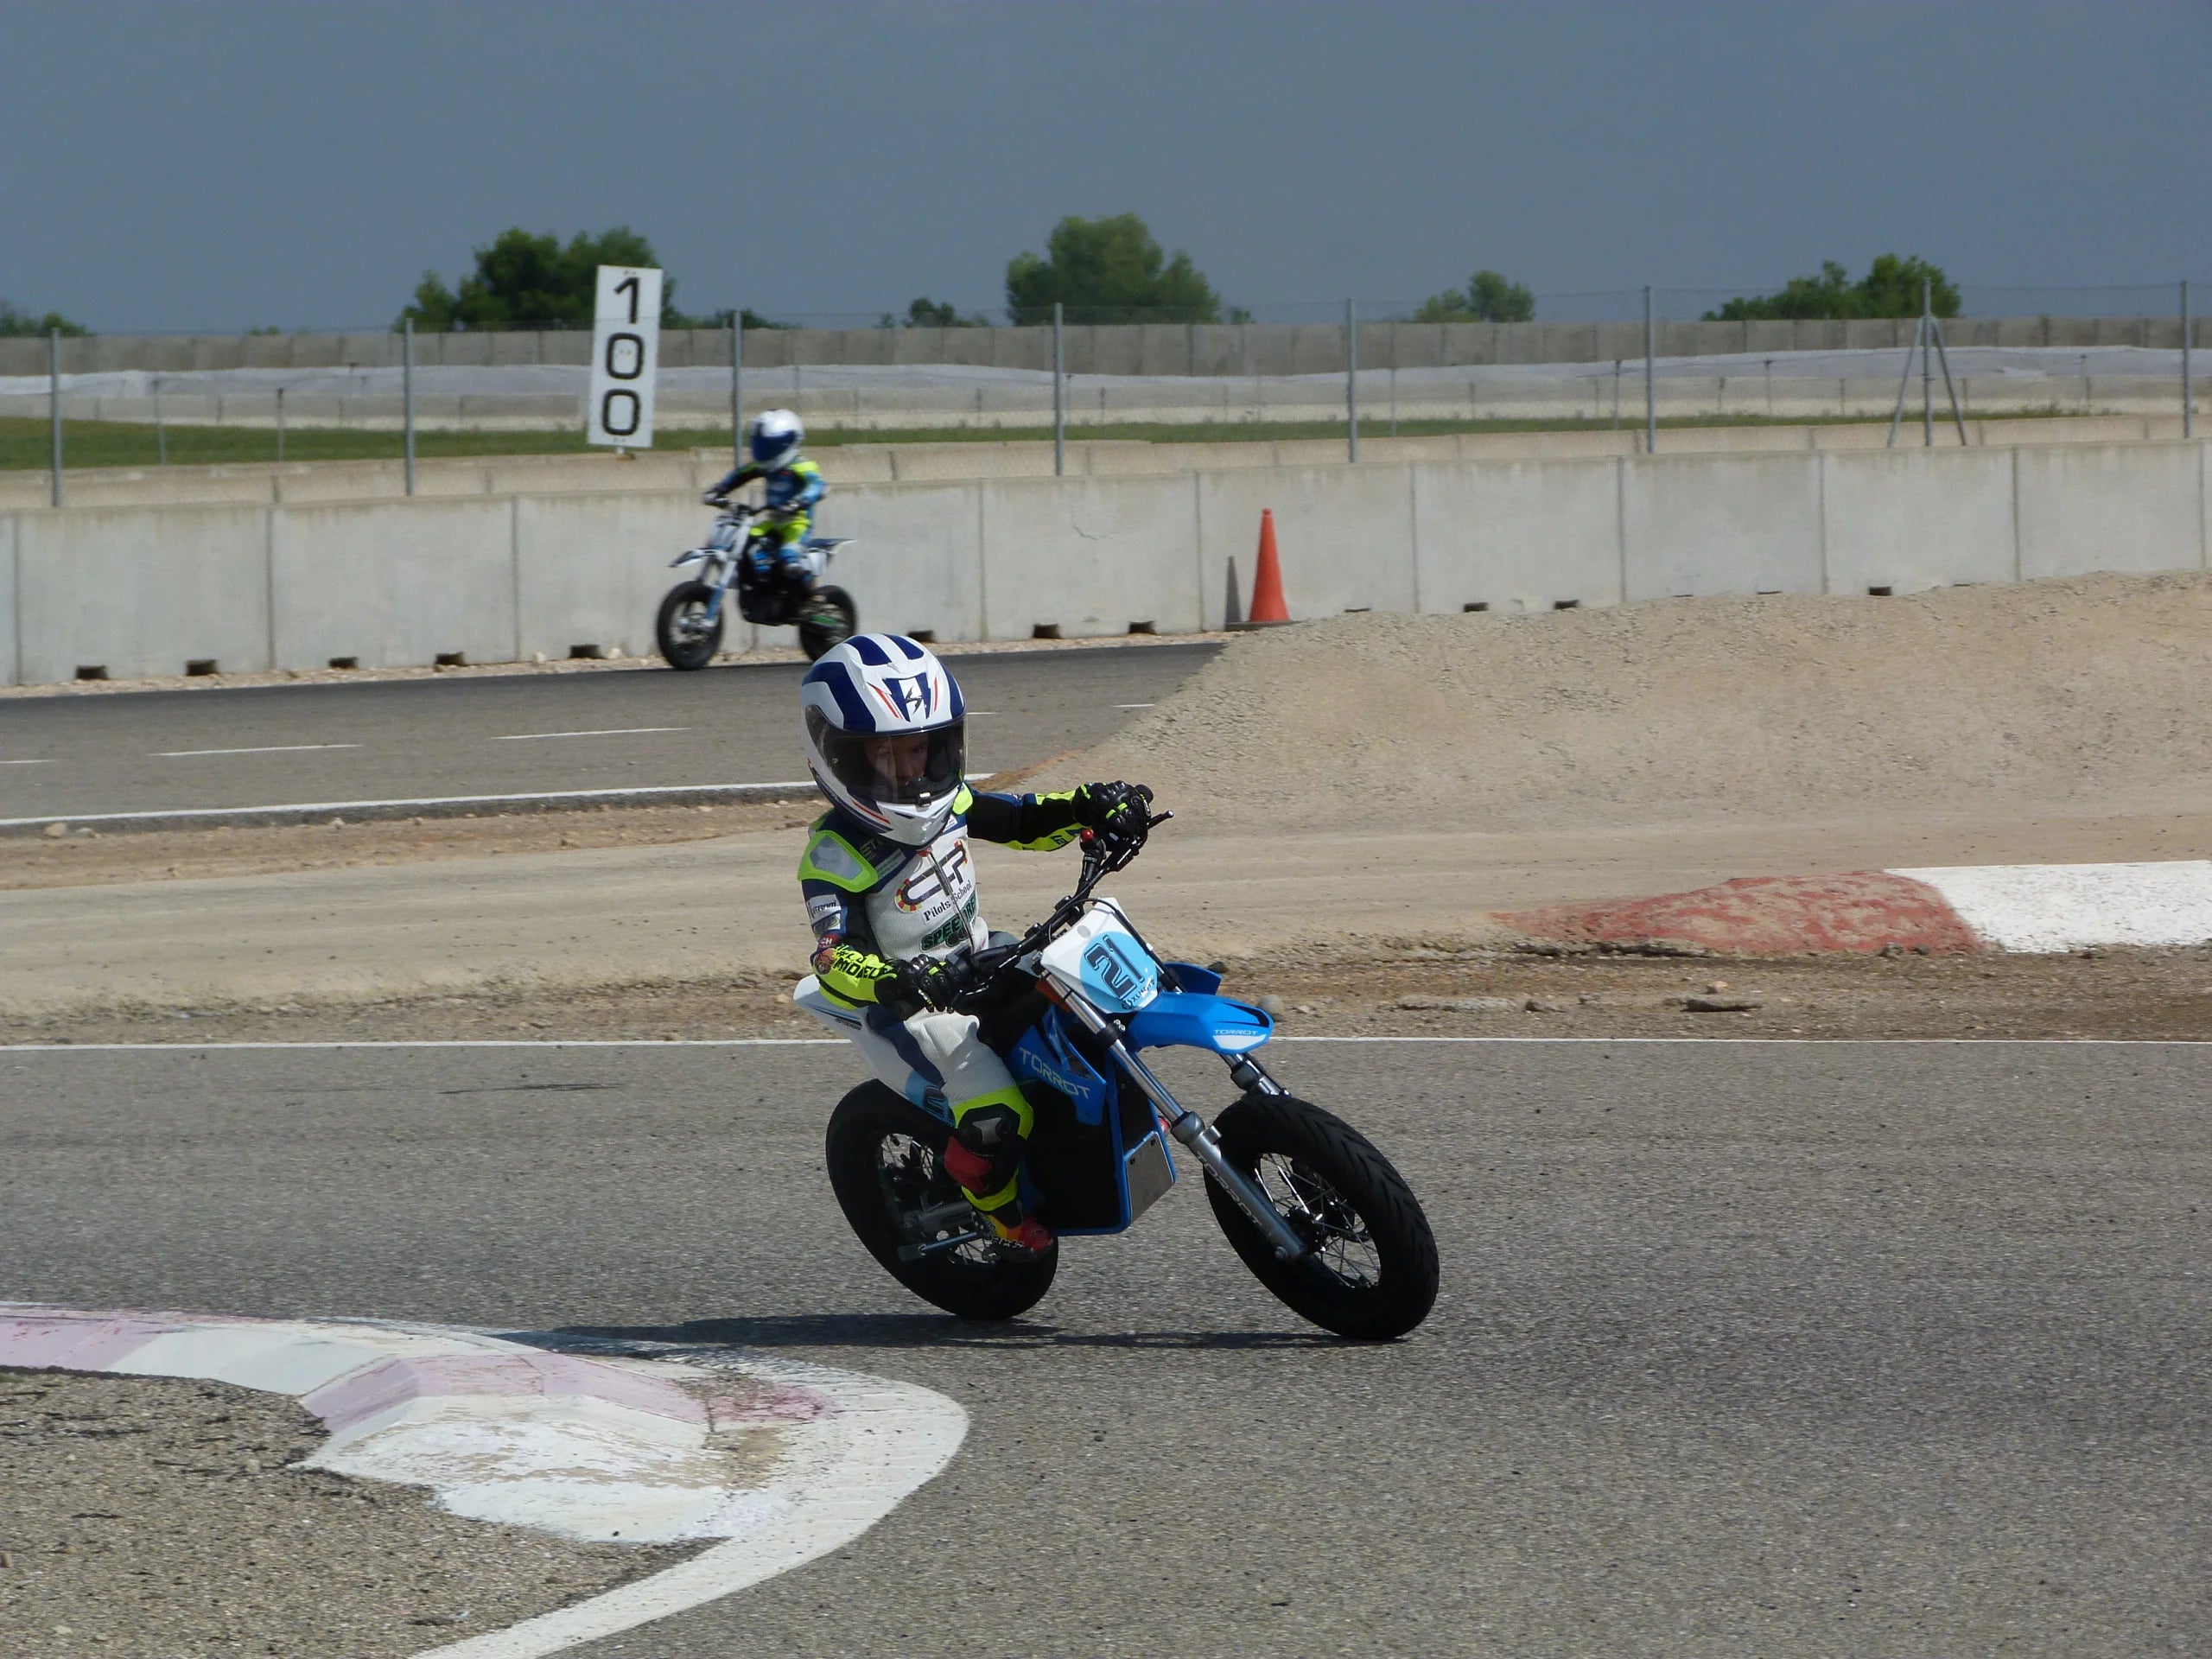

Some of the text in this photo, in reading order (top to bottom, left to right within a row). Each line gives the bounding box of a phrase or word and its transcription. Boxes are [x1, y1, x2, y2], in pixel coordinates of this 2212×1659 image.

[601, 277, 644, 436] 100
[923, 880, 972, 922] Pilots School
[1084, 935, 1145, 1001] 21
[1020, 1047, 1090, 1099] TORROT
